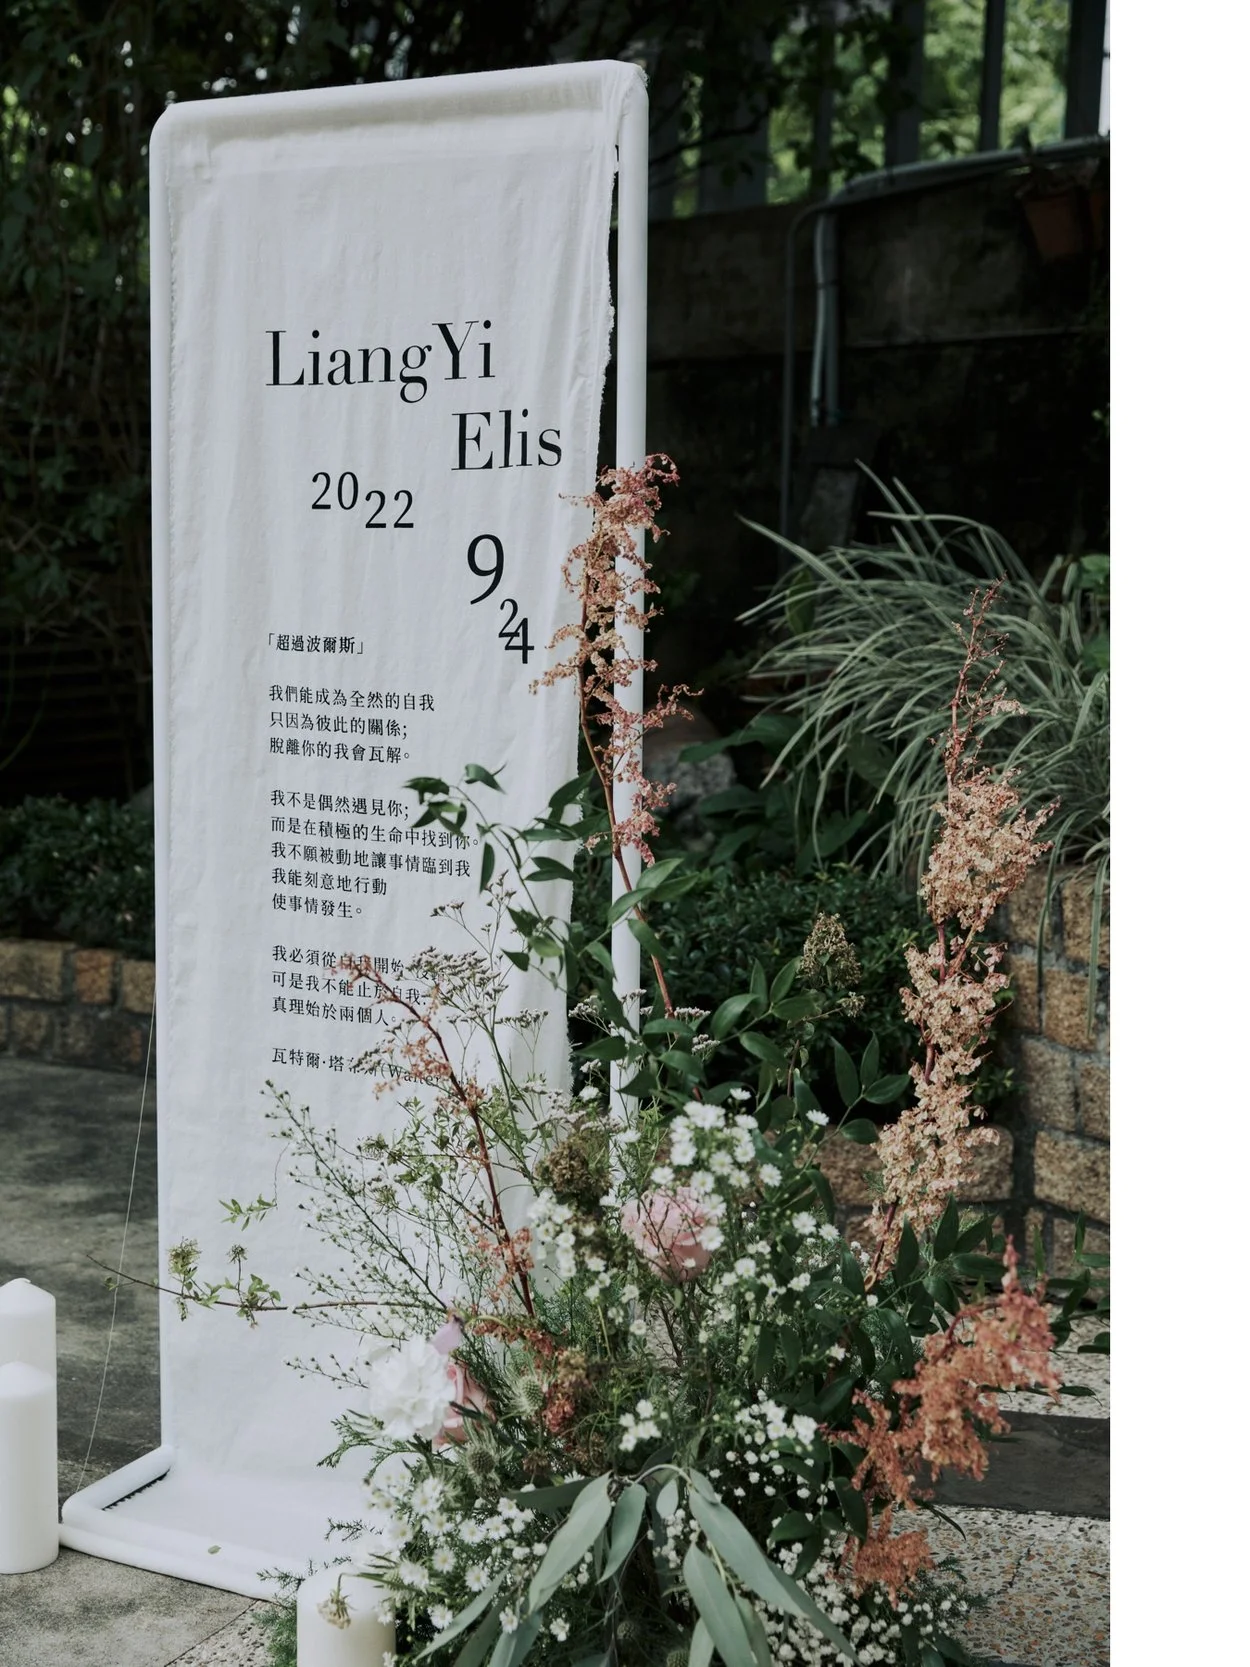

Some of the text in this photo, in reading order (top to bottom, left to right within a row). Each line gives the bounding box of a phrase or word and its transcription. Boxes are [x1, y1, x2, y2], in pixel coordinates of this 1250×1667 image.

[265, 319, 496, 404] LiangYi
[451, 408, 562, 471] Elis
[311, 471, 415, 529] 2022
[467, 534, 505, 605] 9
[268, 633, 364, 655] 「超過波爾斯」
[269, 685, 435, 711] 我們能成為全然的自我
[269, 737, 410, 764] 脫離你的我會瓦解。
[271, 841, 471, 878] 我不願被動地讓事情臨到我
[271, 867, 387, 896] 我能刻意地行動
[272, 893, 362, 919] 使事情發生。
[272, 996, 397, 1027] 真理始於兩個人。
